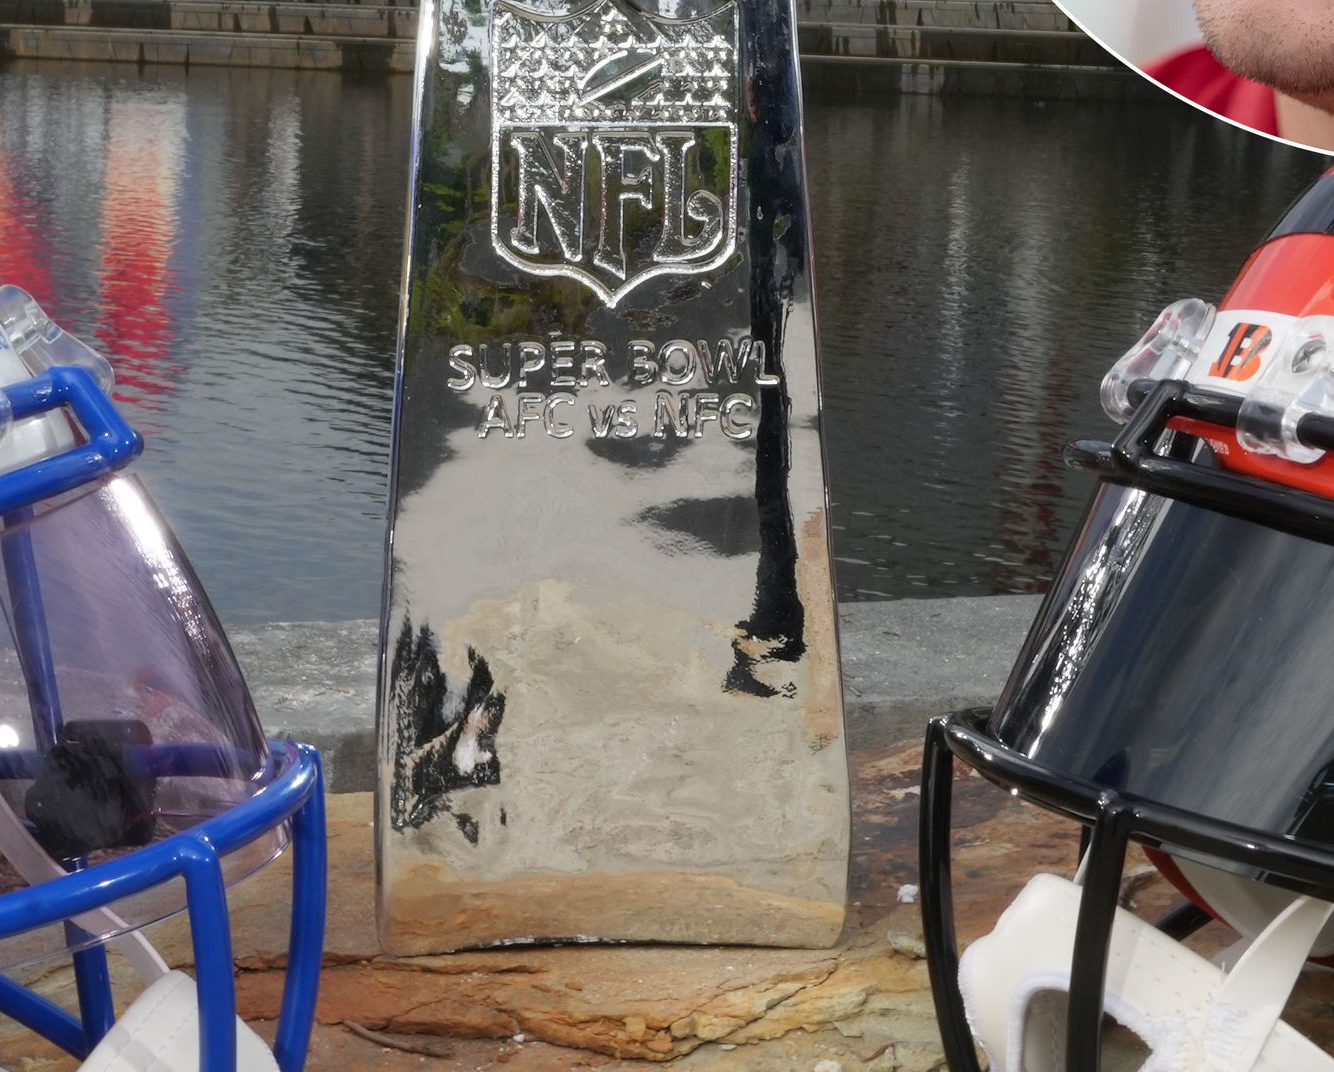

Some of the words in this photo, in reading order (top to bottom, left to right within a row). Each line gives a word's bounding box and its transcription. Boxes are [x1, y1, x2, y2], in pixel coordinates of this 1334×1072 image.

[510, 130, 727, 280] NFL
[447, 339, 610, 390] SUPER
[626, 338, 780, 386] BOWL
[1208, 322, 1272, 382] B
[477, 391, 578, 439] AFC
[652, 391, 754, 439] NFC
